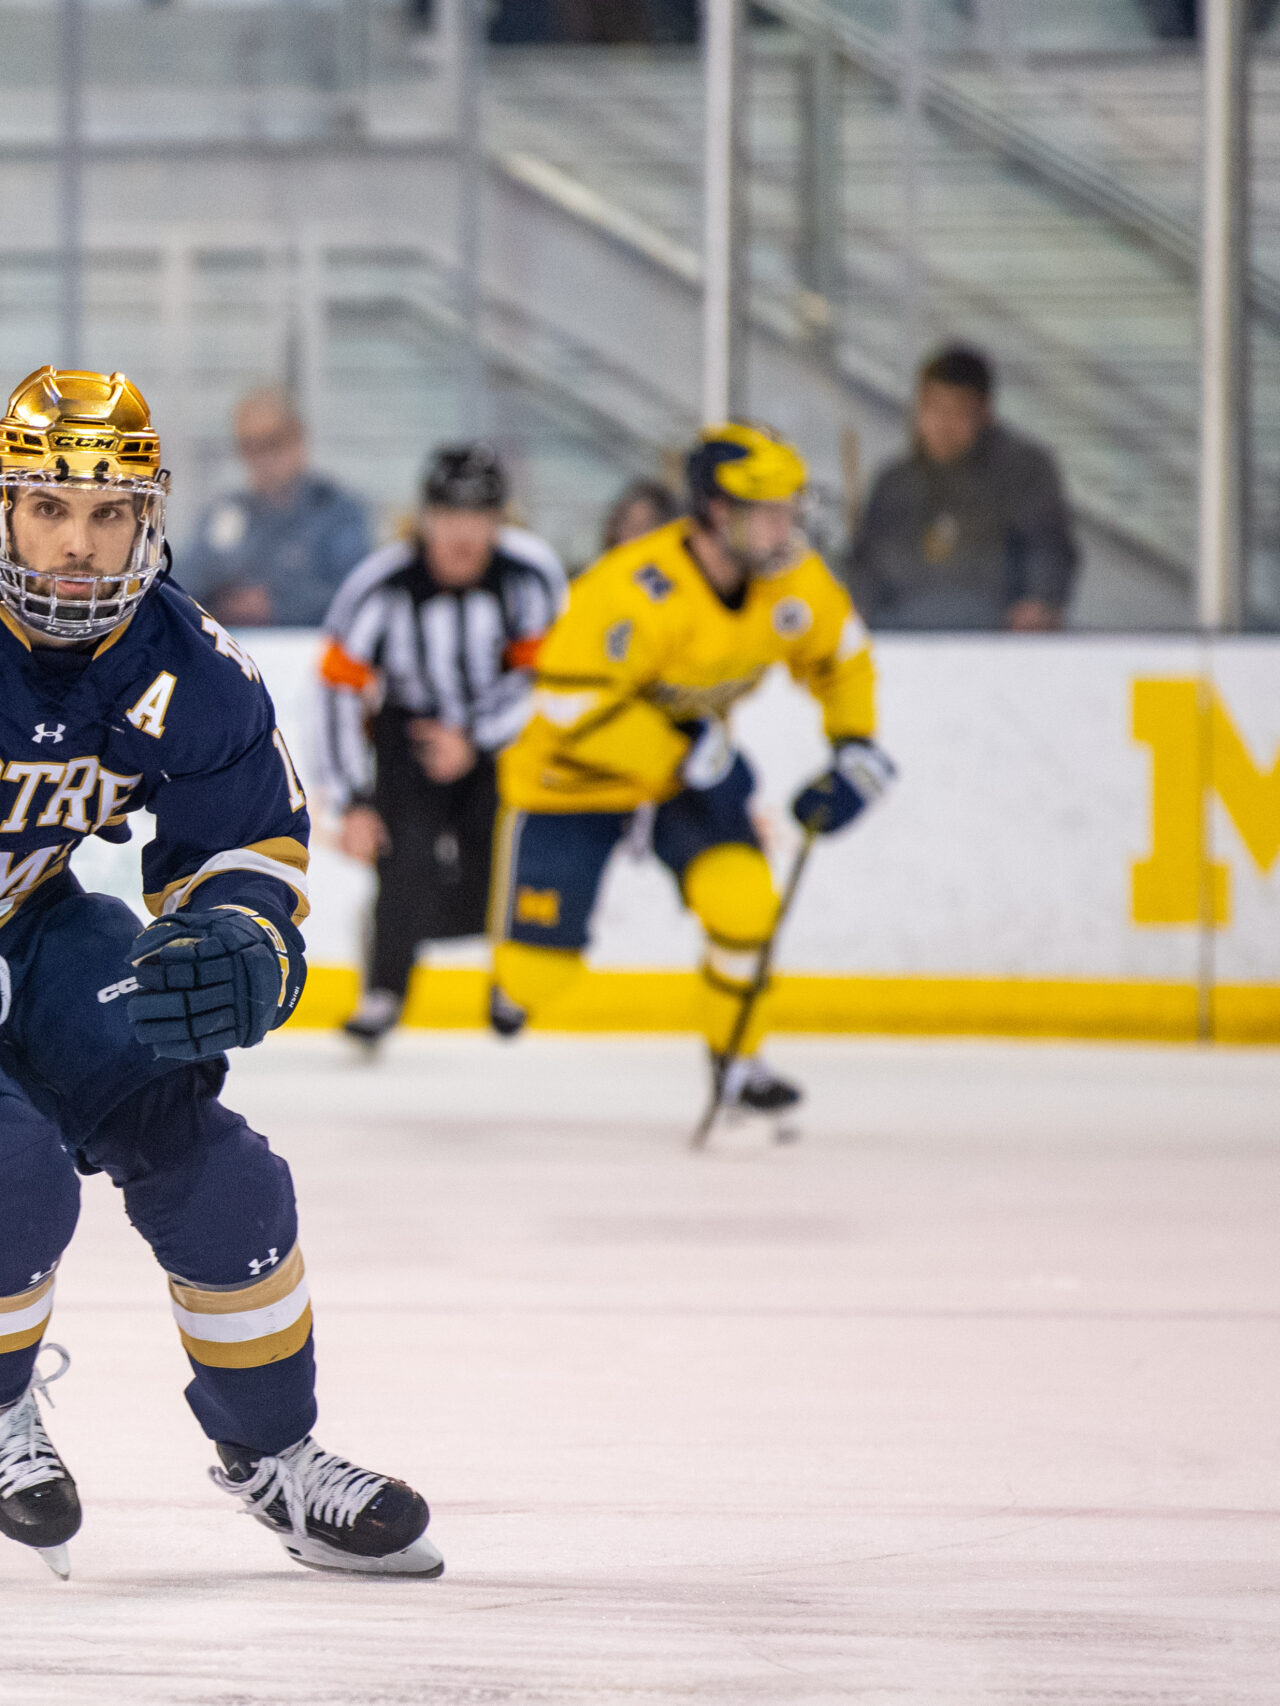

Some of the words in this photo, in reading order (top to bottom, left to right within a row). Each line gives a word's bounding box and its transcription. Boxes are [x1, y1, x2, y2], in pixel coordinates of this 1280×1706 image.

[54, 436, 115, 449] CCM
[125, 670, 178, 739] A
[96, 976, 143, 1004] CC
